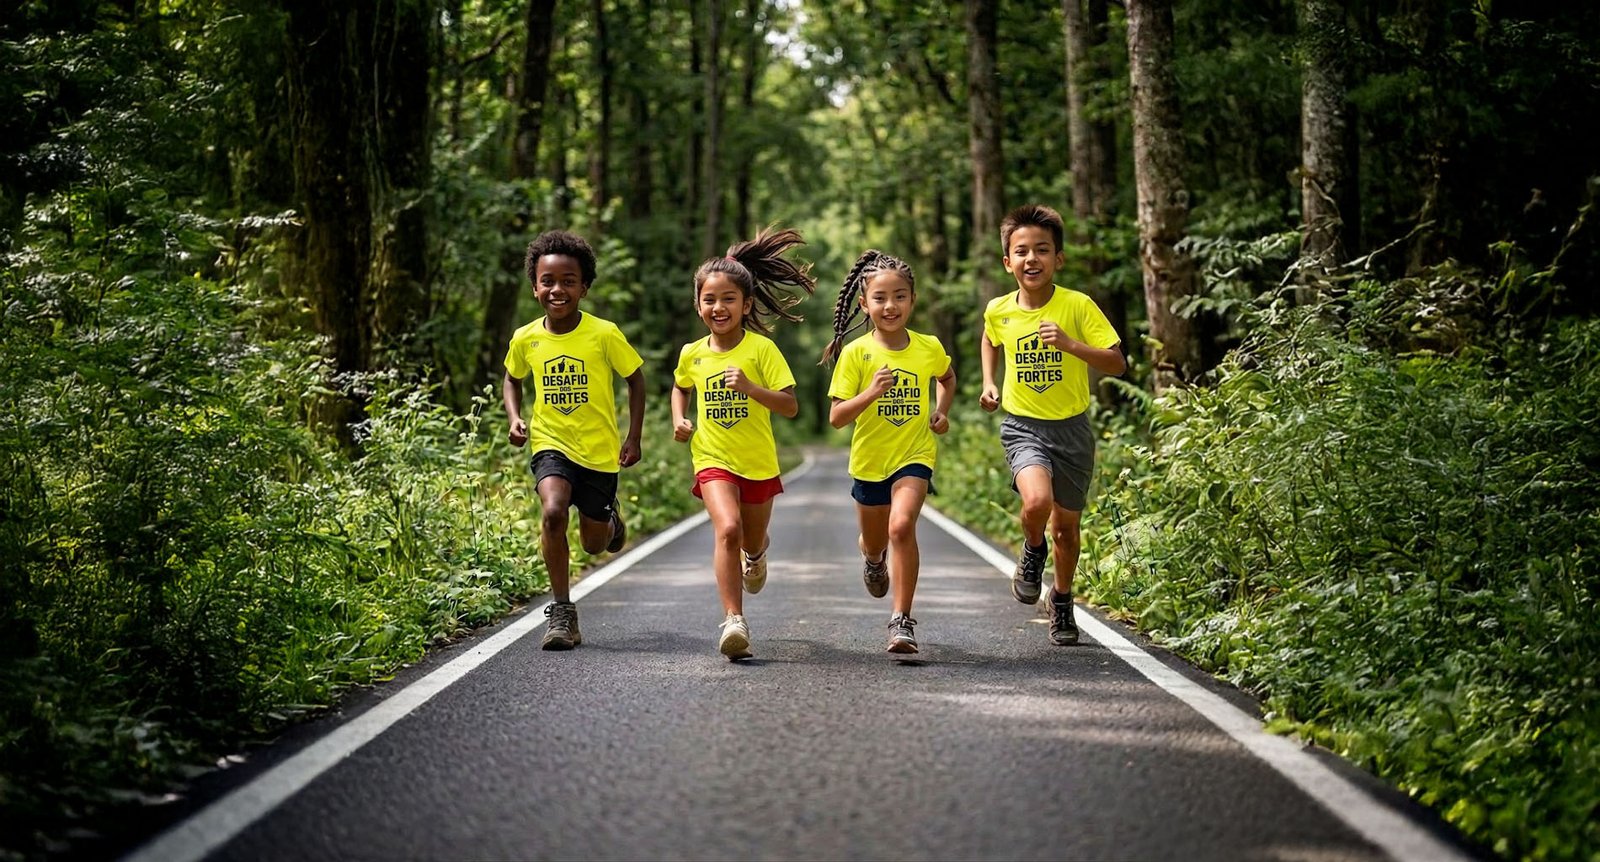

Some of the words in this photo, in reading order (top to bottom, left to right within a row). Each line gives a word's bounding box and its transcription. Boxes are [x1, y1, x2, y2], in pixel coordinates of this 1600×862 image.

[1016, 352, 1062, 364] DESAFIO
[543, 374, 588, 386] DESAFIO
[1017, 370, 1062, 382] FORTES
[544, 392, 588, 404] FORTES
[880, 388, 920, 398] ESAFIO
[706, 408, 748, 419] FORTES
[878, 404, 920, 416] FORTES
